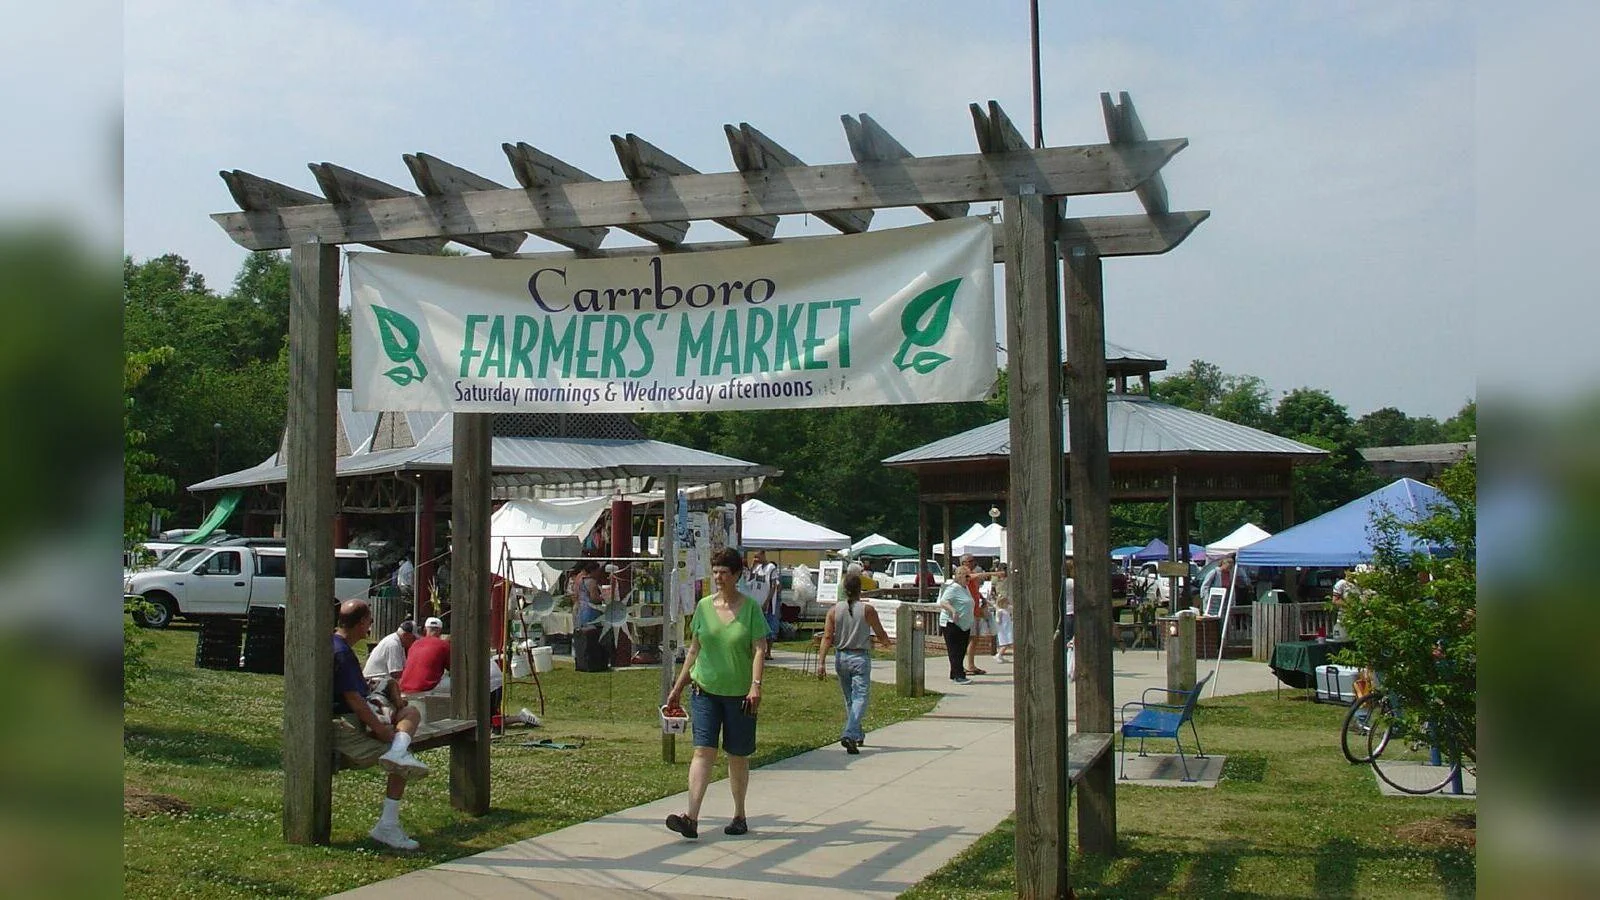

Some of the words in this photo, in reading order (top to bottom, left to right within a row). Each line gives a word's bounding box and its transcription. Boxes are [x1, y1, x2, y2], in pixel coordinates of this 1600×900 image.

[528, 256, 776, 312] Carrboro
[460, 312, 668, 379] FARMERS'
[676, 298, 861, 377] MARKET
[455, 380, 520, 405] Saturday
[524, 382, 600, 406] mornings
[604, 381, 617, 401] &
[622, 379, 714, 404] Wednesday
[718, 377, 813, 400] afternoons
